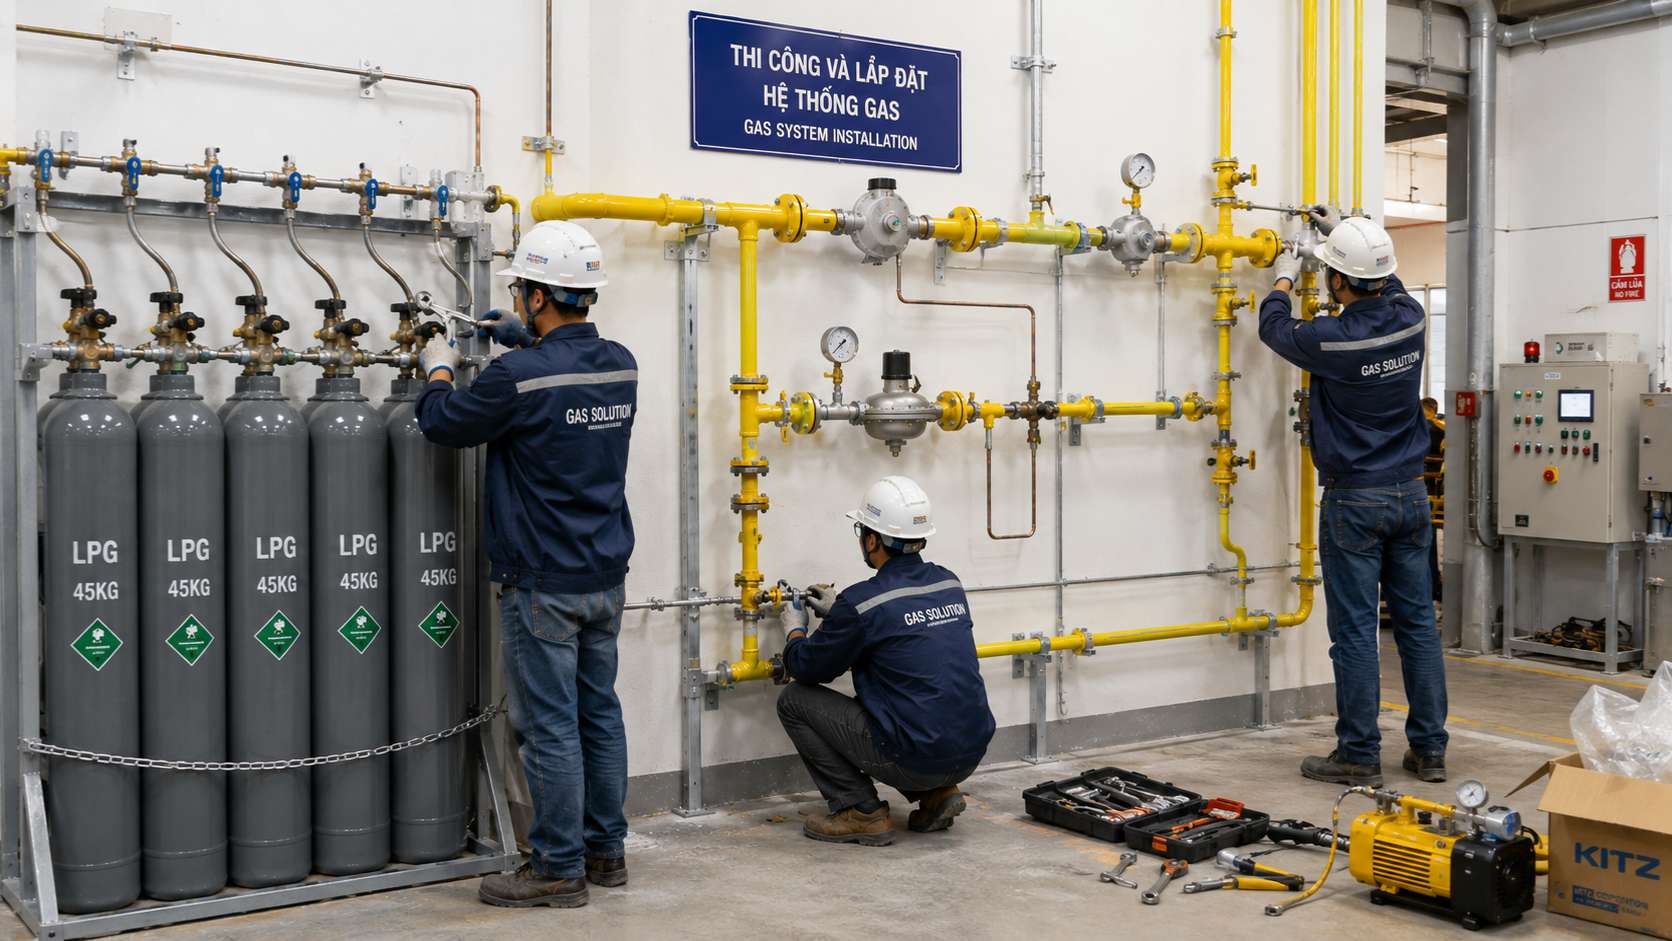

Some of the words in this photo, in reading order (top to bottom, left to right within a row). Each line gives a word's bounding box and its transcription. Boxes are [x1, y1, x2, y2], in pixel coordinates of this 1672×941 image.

[730, 43, 762, 69] THI
[768, 46, 821, 77] CÔNG
[826, 53, 850, 81] VÀ
[894, 64, 929, 94] ĐẶT
[763, 81, 788, 112] HỆ
[795, 85, 859, 117] THỐNG
[864, 97, 901, 121] GAS
[744, 118, 772, 136] GAS
[776, 122, 828, 142] SYSTEM
[833, 128, 918, 151] INSTALLATION
[1361, 363, 1381, 376] GAS
[1383, 350, 1420, 372] SOLUTION
[566, 408, 589, 425] GAS
[591, 403, 632, 422] SOLUTION
[72, 540, 118, 564] LPG
[167, 538, 210, 562] LPG
[256, 535, 297, 559] LPG
[339, 533, 378, 556] LPG
[420, 531, 456, 553] LPG
[168, 578, 211, 597] 45KG
[257, 575, 297, 594] 45KG
[340, 571, 378, 589] 45KG
[420, 568, 457, 586] 45KG
[73, 581, 119, 601] 45KG
[904, 610, 926, 626] GAS
[926, 603, 967, 620] SOLUTION
[1574, 842, 1661, 881] KITZ
